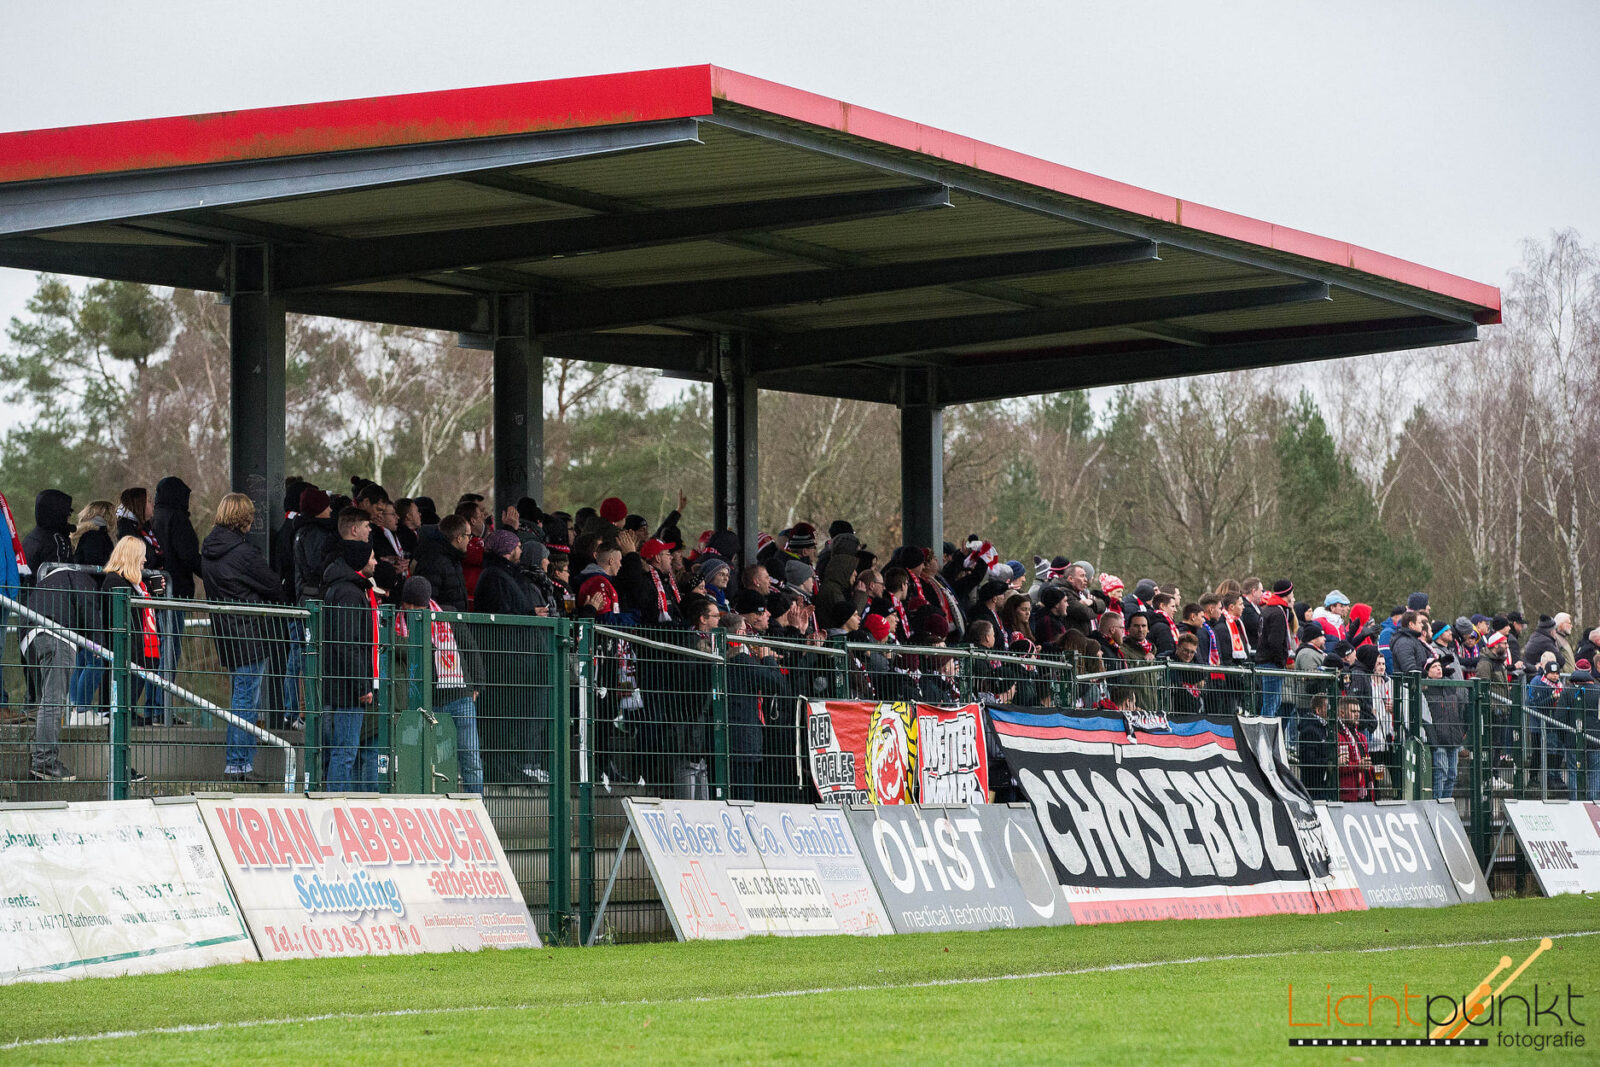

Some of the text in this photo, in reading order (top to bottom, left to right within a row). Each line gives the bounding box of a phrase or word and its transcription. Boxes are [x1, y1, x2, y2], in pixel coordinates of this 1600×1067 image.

[809, 713, 831, 748] RED
[919, 712, 980, 775] WEITER
[814, 752, 855, 786] EAGLES
[333, 807, 494, 864] ABBRUCH
[642, 809, 852, 856] Weber & Co. GmbH
[1018, 766, 1297, 879] CHOSEBUZ
[872, 818, 995, 894] OHST
[1343, 813, 1432, 876] OHST
[293, 870, 402, 914] Schmeling
[427, 863, 508, 898] -arbeiten
[788, 876, 801, 895] 53
[800, 876, 815, 895] 76
[813, 876, 821, 895] 0
[1367, 884, 1400, 903] medical
[1400, 883, 1448, 902] technology
[746, 903, 833, 922] www.weber-co-gmbh.de
[902, 905, 950, 928] medical
[950, 903, 1016, 926] technology
[371, 925, 391, 951] 53
